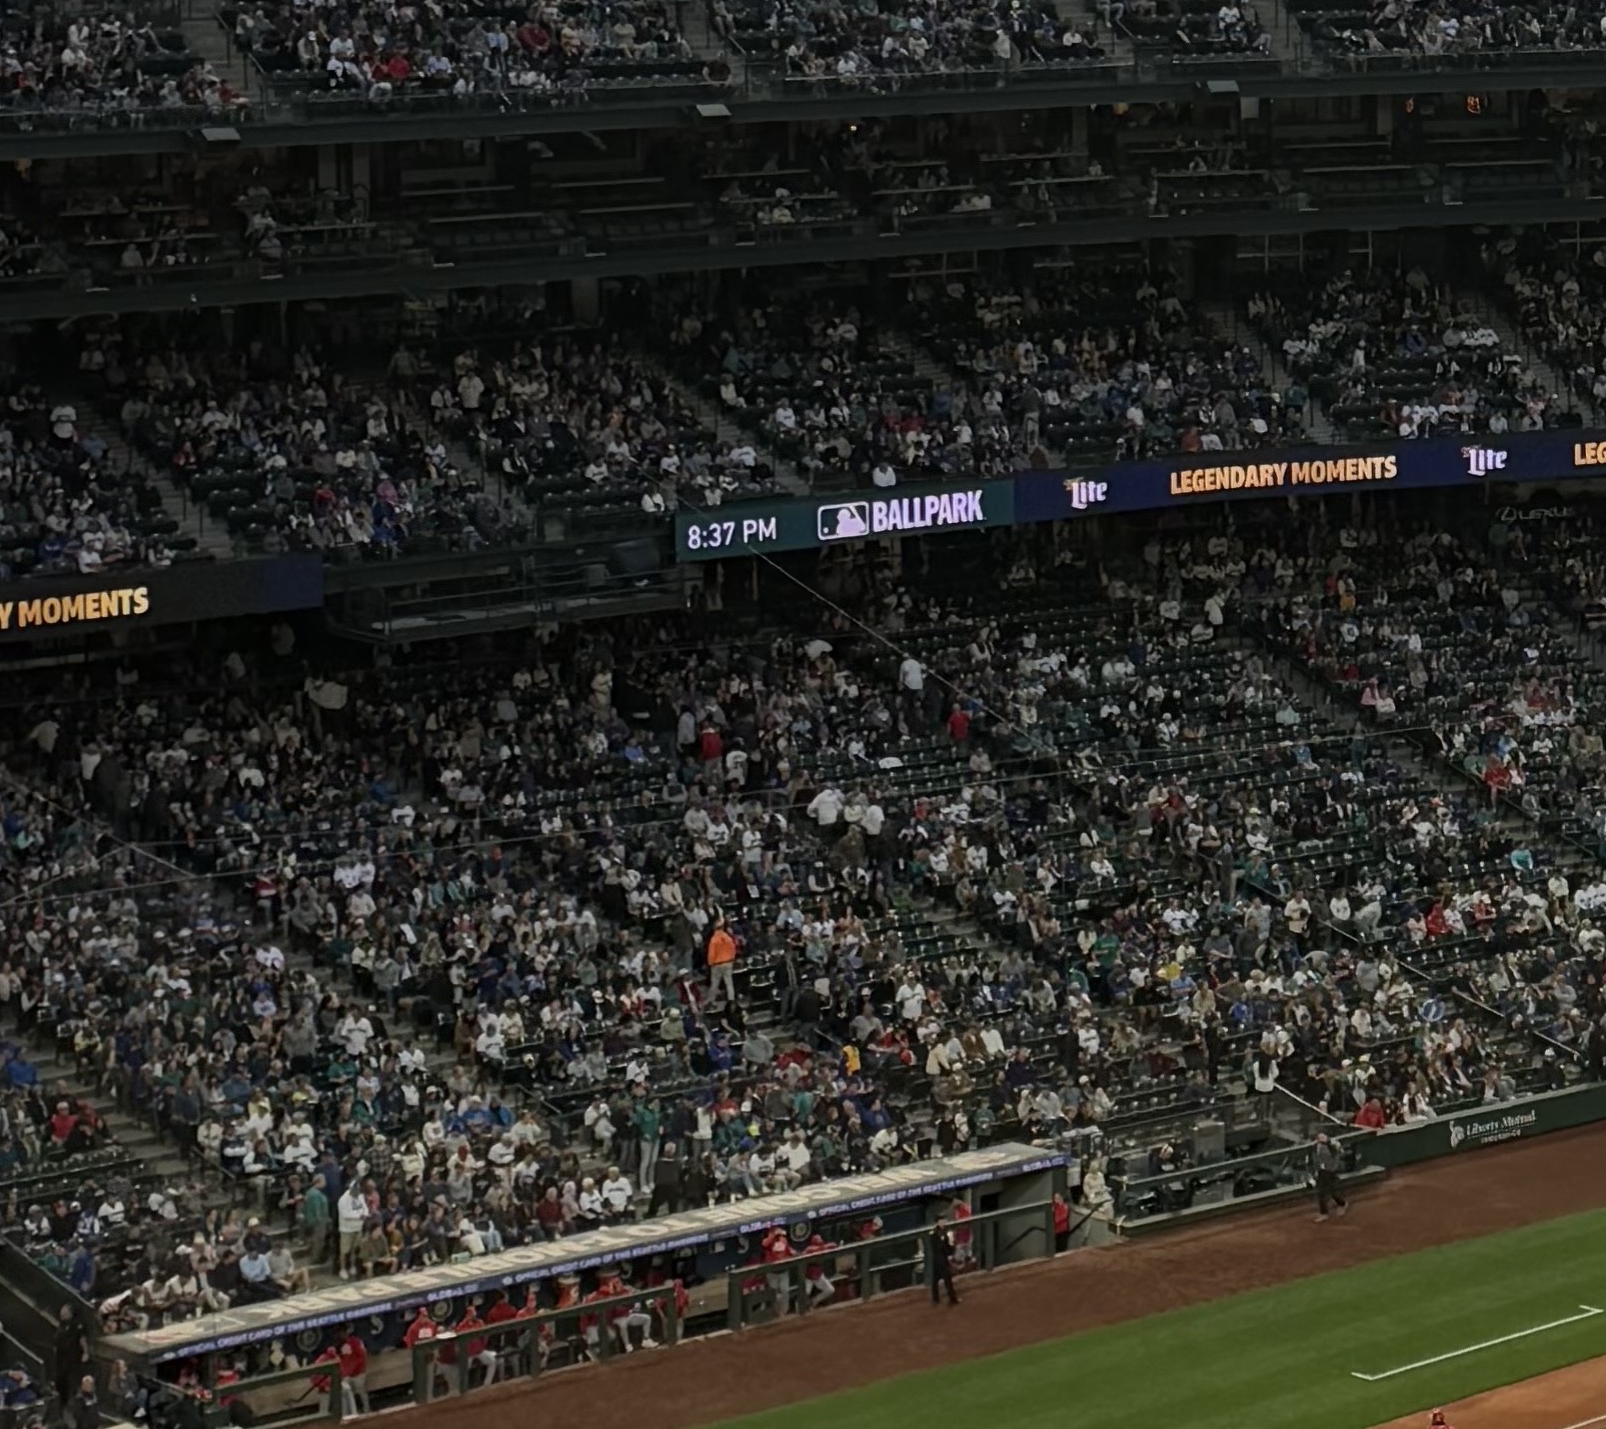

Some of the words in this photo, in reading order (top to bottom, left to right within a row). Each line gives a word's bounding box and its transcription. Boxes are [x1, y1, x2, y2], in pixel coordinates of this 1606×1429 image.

[1170, 462, 1287, 495] LEGENDARY
[1292, 455, 1397, 484] MOMENTS
[1467, 448, 1506, 476] Lite
[872, 490, 984, 532] BALLPARK
[1071, 481, 1108, 510] Lite
[687, 522, 736, 550] 8:37
[743, 517, 777, 543] PM
[19, 587, 149, 627] MOMENTS
